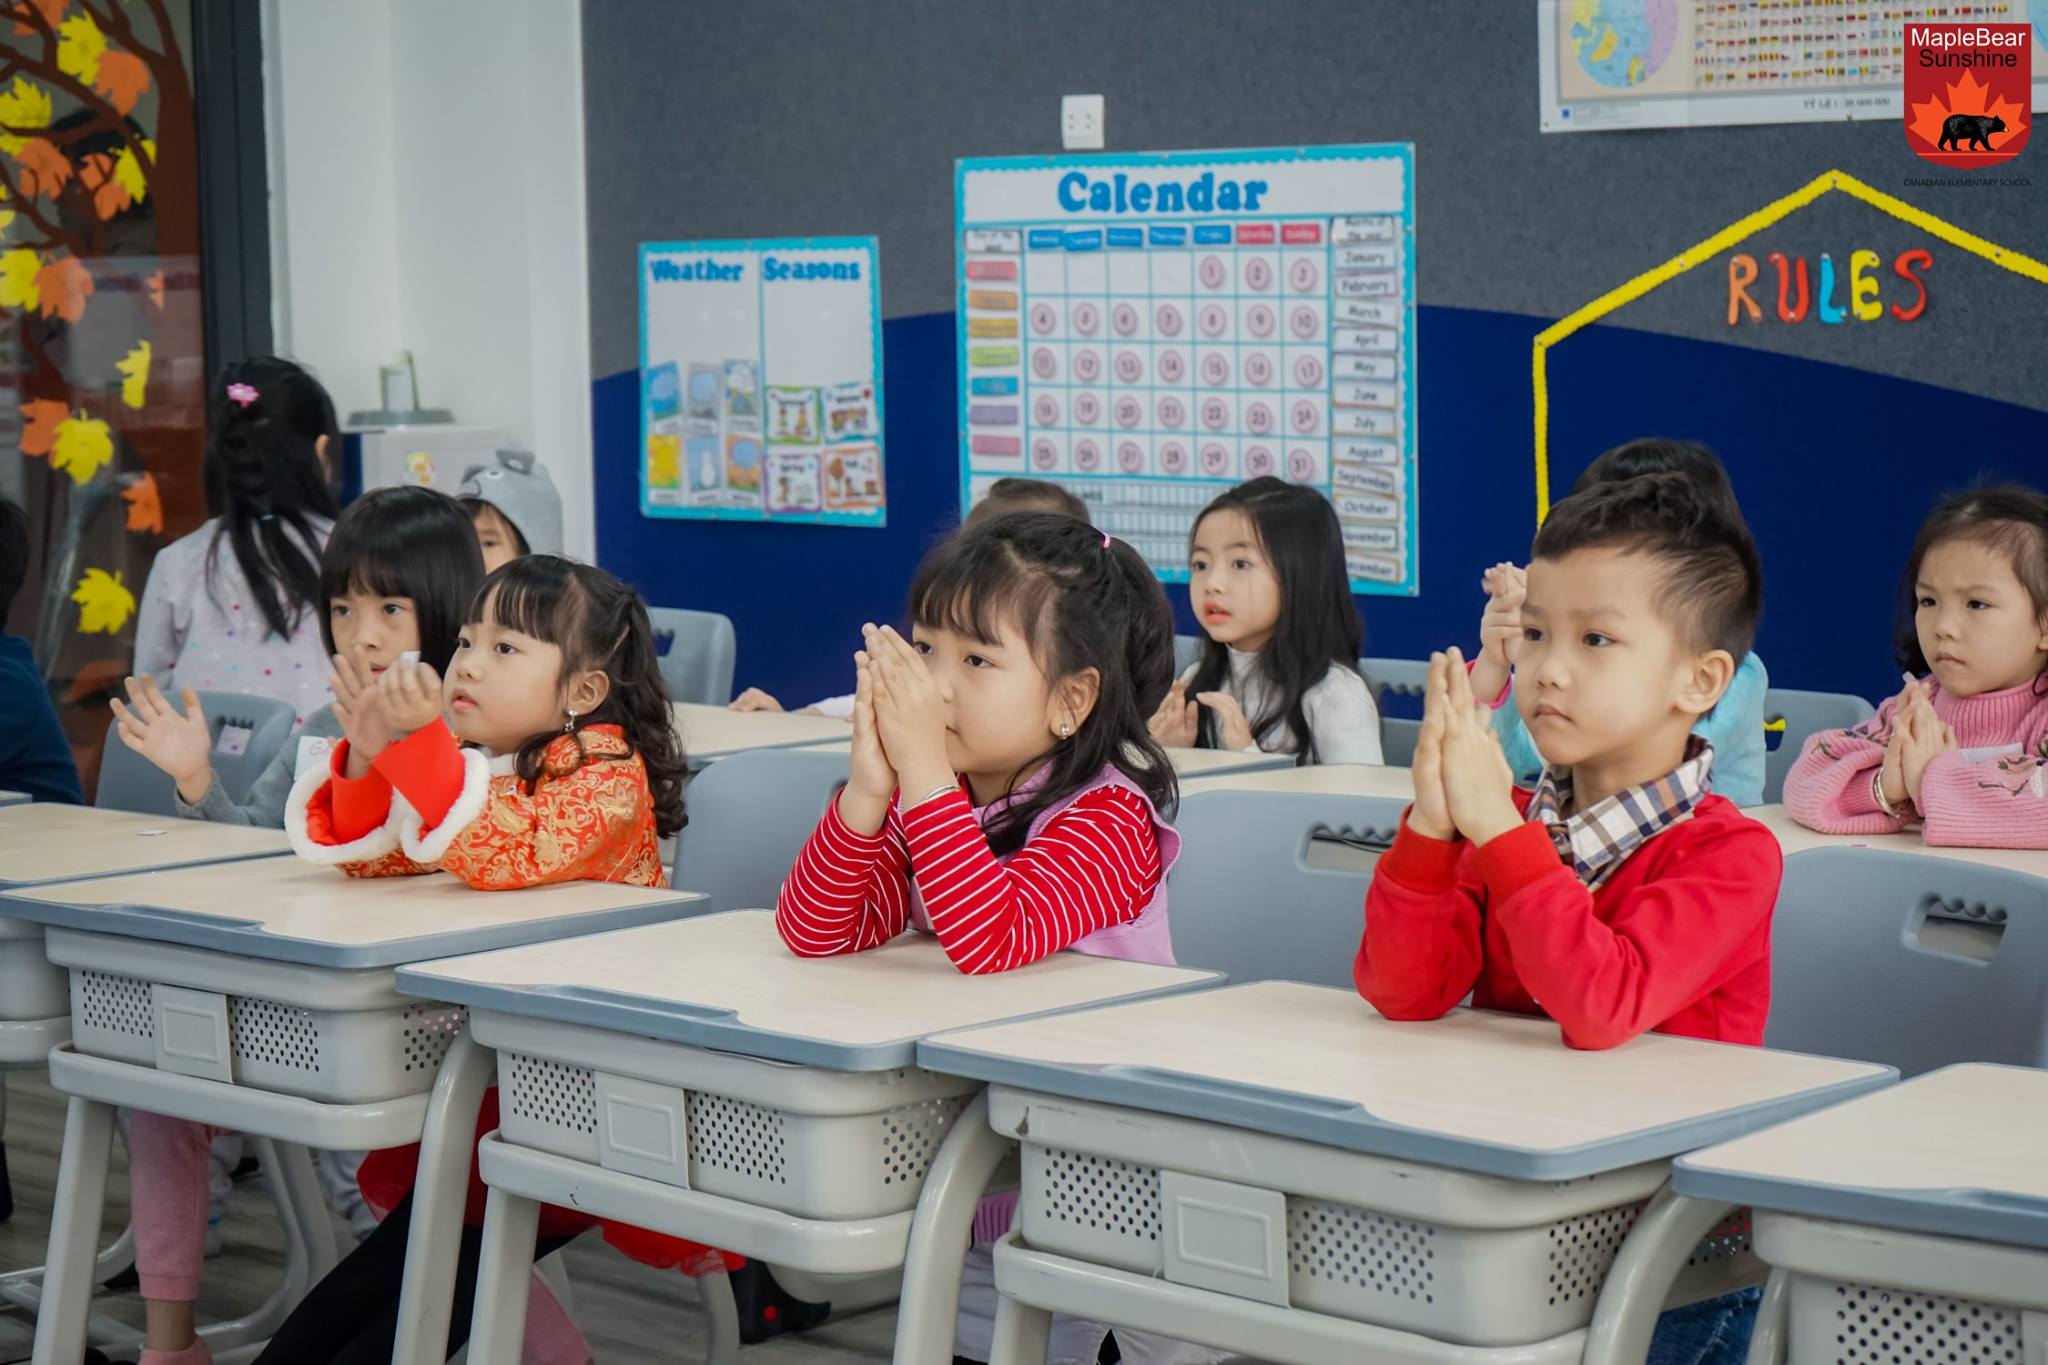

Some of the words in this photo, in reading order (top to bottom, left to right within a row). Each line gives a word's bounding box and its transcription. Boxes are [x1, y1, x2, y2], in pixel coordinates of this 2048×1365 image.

[1056, 171, 1268, 214] Calendar
[1344, 251, 1385, 264] January
[650, 258, 744, 281] Weather
[763, 257, 861, 282] Seasons
[1342, 278, 1389, 294] February
[1727, 248, 1933, 325] RULES
[1349, 305, 1382, 319] March
[1354, 333, 1379, 347] April
[1354, 360, 1376, 374] May
[1353, 388, 1378, 401] June
[1354, 416, 1376, 431] July
[1348, 446, 1384, 460] August
[1337, 468, 1392, 490] September
[1344, 501, 1389, 515] October
